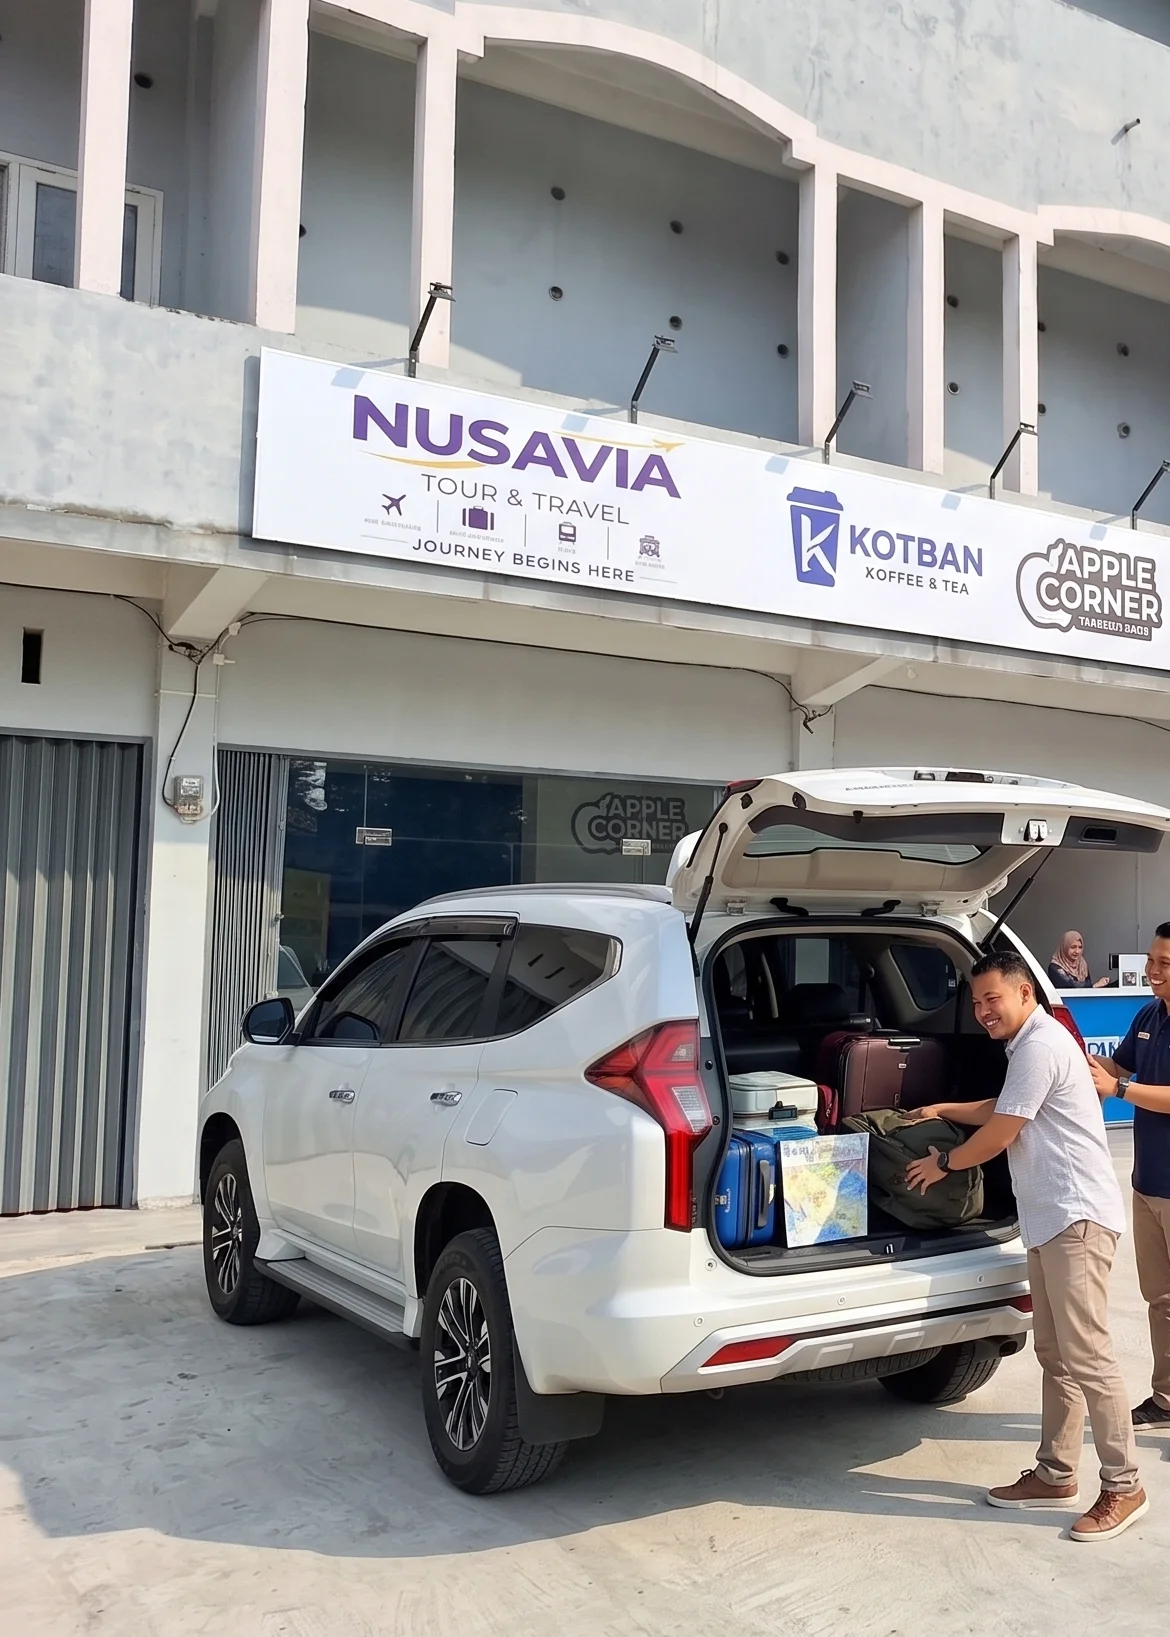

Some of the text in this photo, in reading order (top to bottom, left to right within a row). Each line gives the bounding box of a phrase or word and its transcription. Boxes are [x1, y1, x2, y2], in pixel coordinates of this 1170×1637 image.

[353, 395, 681, 499] NUSAVIA
[421, 473, 630, 525] TOUR & TRAVEL
[412, 538, 506, 562] JOURNEY
[512, 553, 581, 574] BEGINS
[588, 564, 635, 582] HERE
[850, 525, 983, 577] KOTBAN
[1059, 548, 1153, 590] APPLE
[929, 577, 938, 590] &
[942, 579, 970, 596] TEA
[1040, 577, 1159, 623] CORNER
[591, 818, 686, 840] CORNER
[608, 798, 682, 820] APPLE
